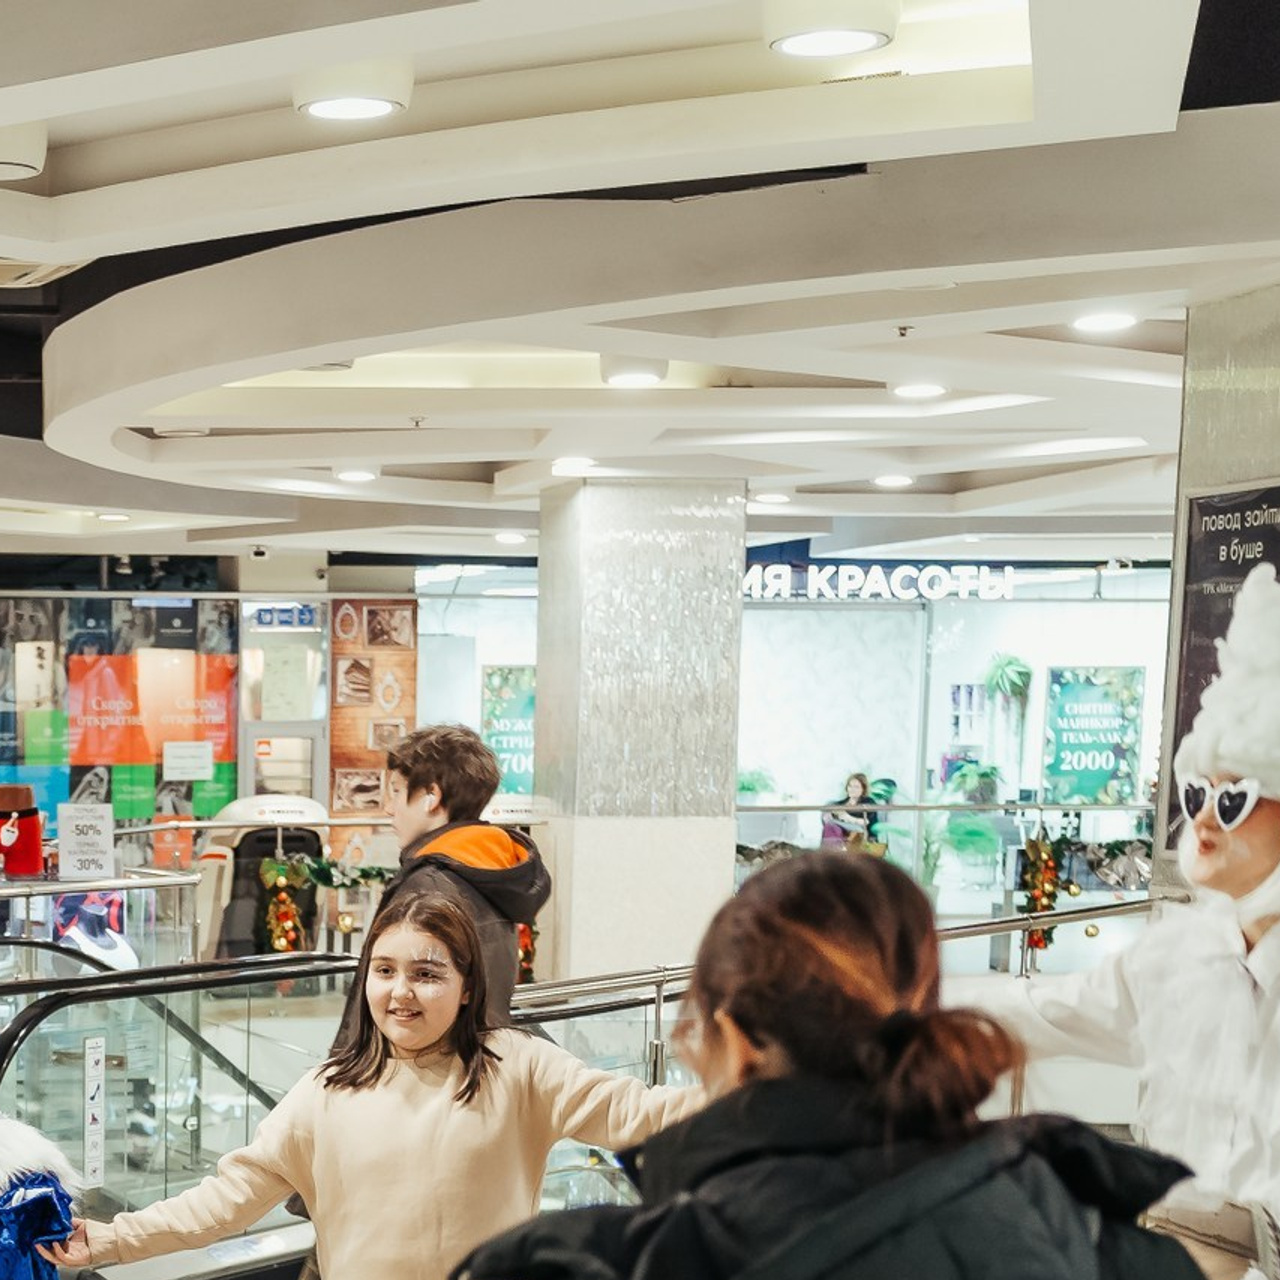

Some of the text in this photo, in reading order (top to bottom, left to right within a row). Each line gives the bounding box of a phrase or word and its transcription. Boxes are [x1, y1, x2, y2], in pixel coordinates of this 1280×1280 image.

[1202, 512, 1241, 532] повод
[1220, 537, 1263, 564] в буше
[806, 563, 1015, 600] КРАСОТЫ
[1059, 750, 1115, 771] 2000
[72, 824, 102, 836] -50%
[74, 858, 104, 871] -30%
